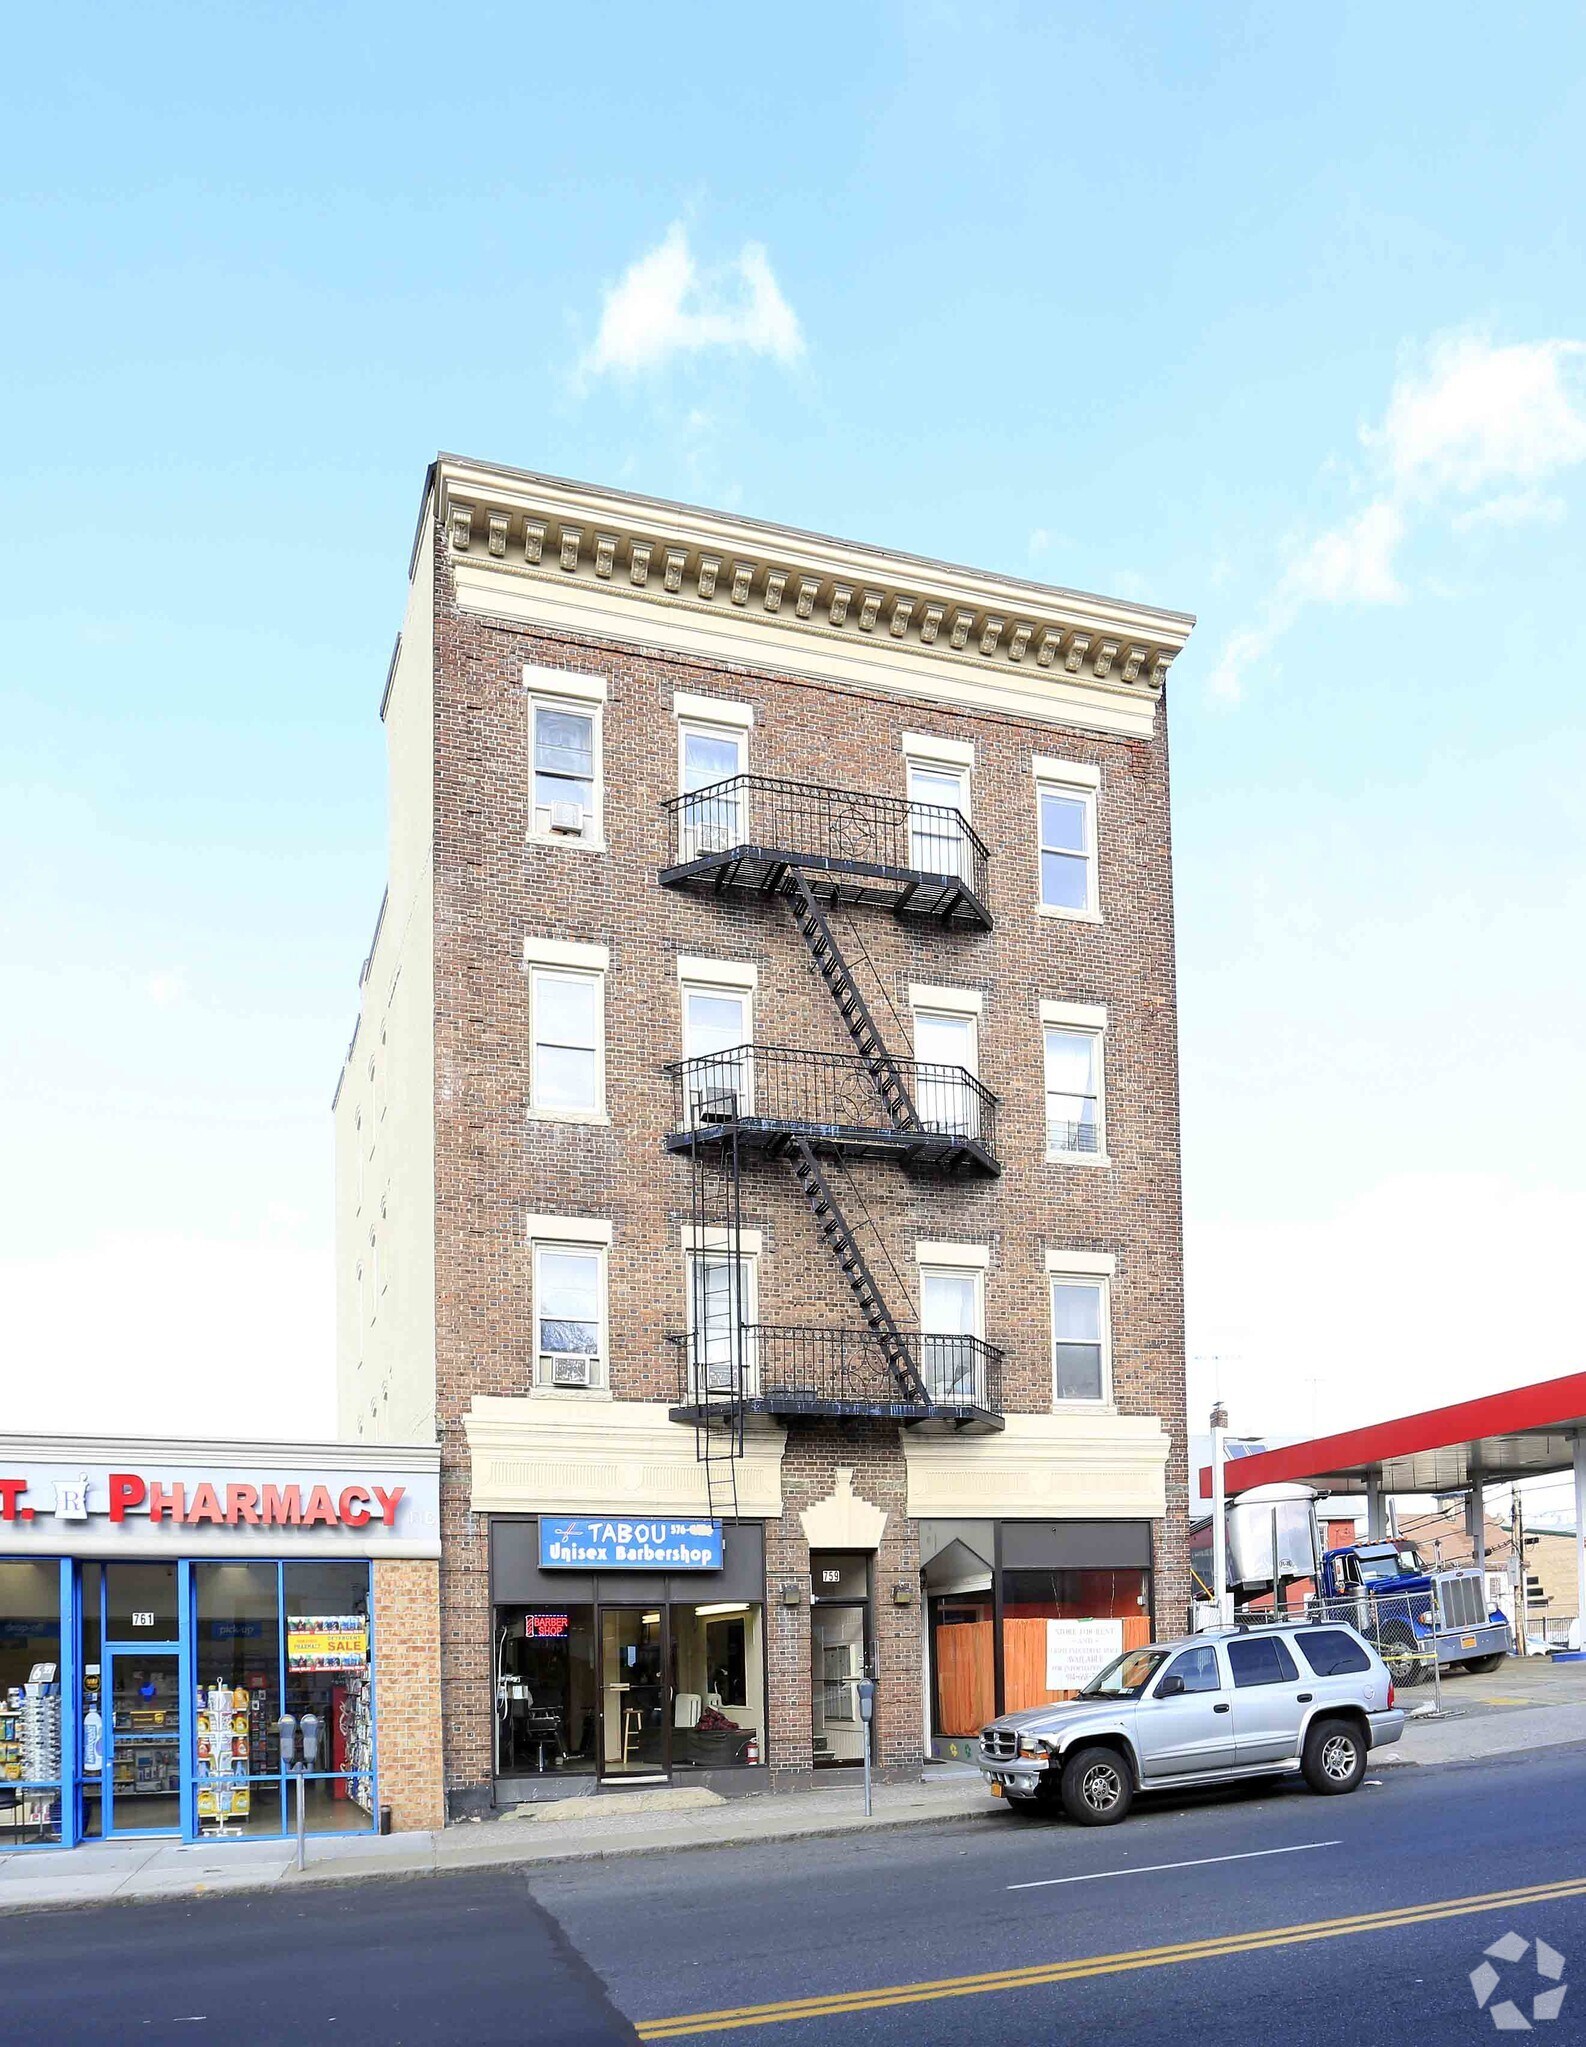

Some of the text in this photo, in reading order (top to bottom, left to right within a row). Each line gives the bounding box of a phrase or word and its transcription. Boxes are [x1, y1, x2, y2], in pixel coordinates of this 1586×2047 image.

[109, 1473, 406, 1527] PHARMACY
[587, 1523, 667, 1544] TABOU
[549, 1542, 713, 1566] Unisex Barbershop
[824, 1571, 839, 1581] 759
[134, 1613, 152, 1625] 761
[534, 1617, 568, 1627] BARBER
[219, 1623, 255, 1637] pick-up
[538, 1626, 563, 1636] SHOP
[1095, 1627, 1114, 1635] RENT
[327, 1641, 362, 1651] SALE
[1067, 1655, 1104, 1664] AVAILABLE
